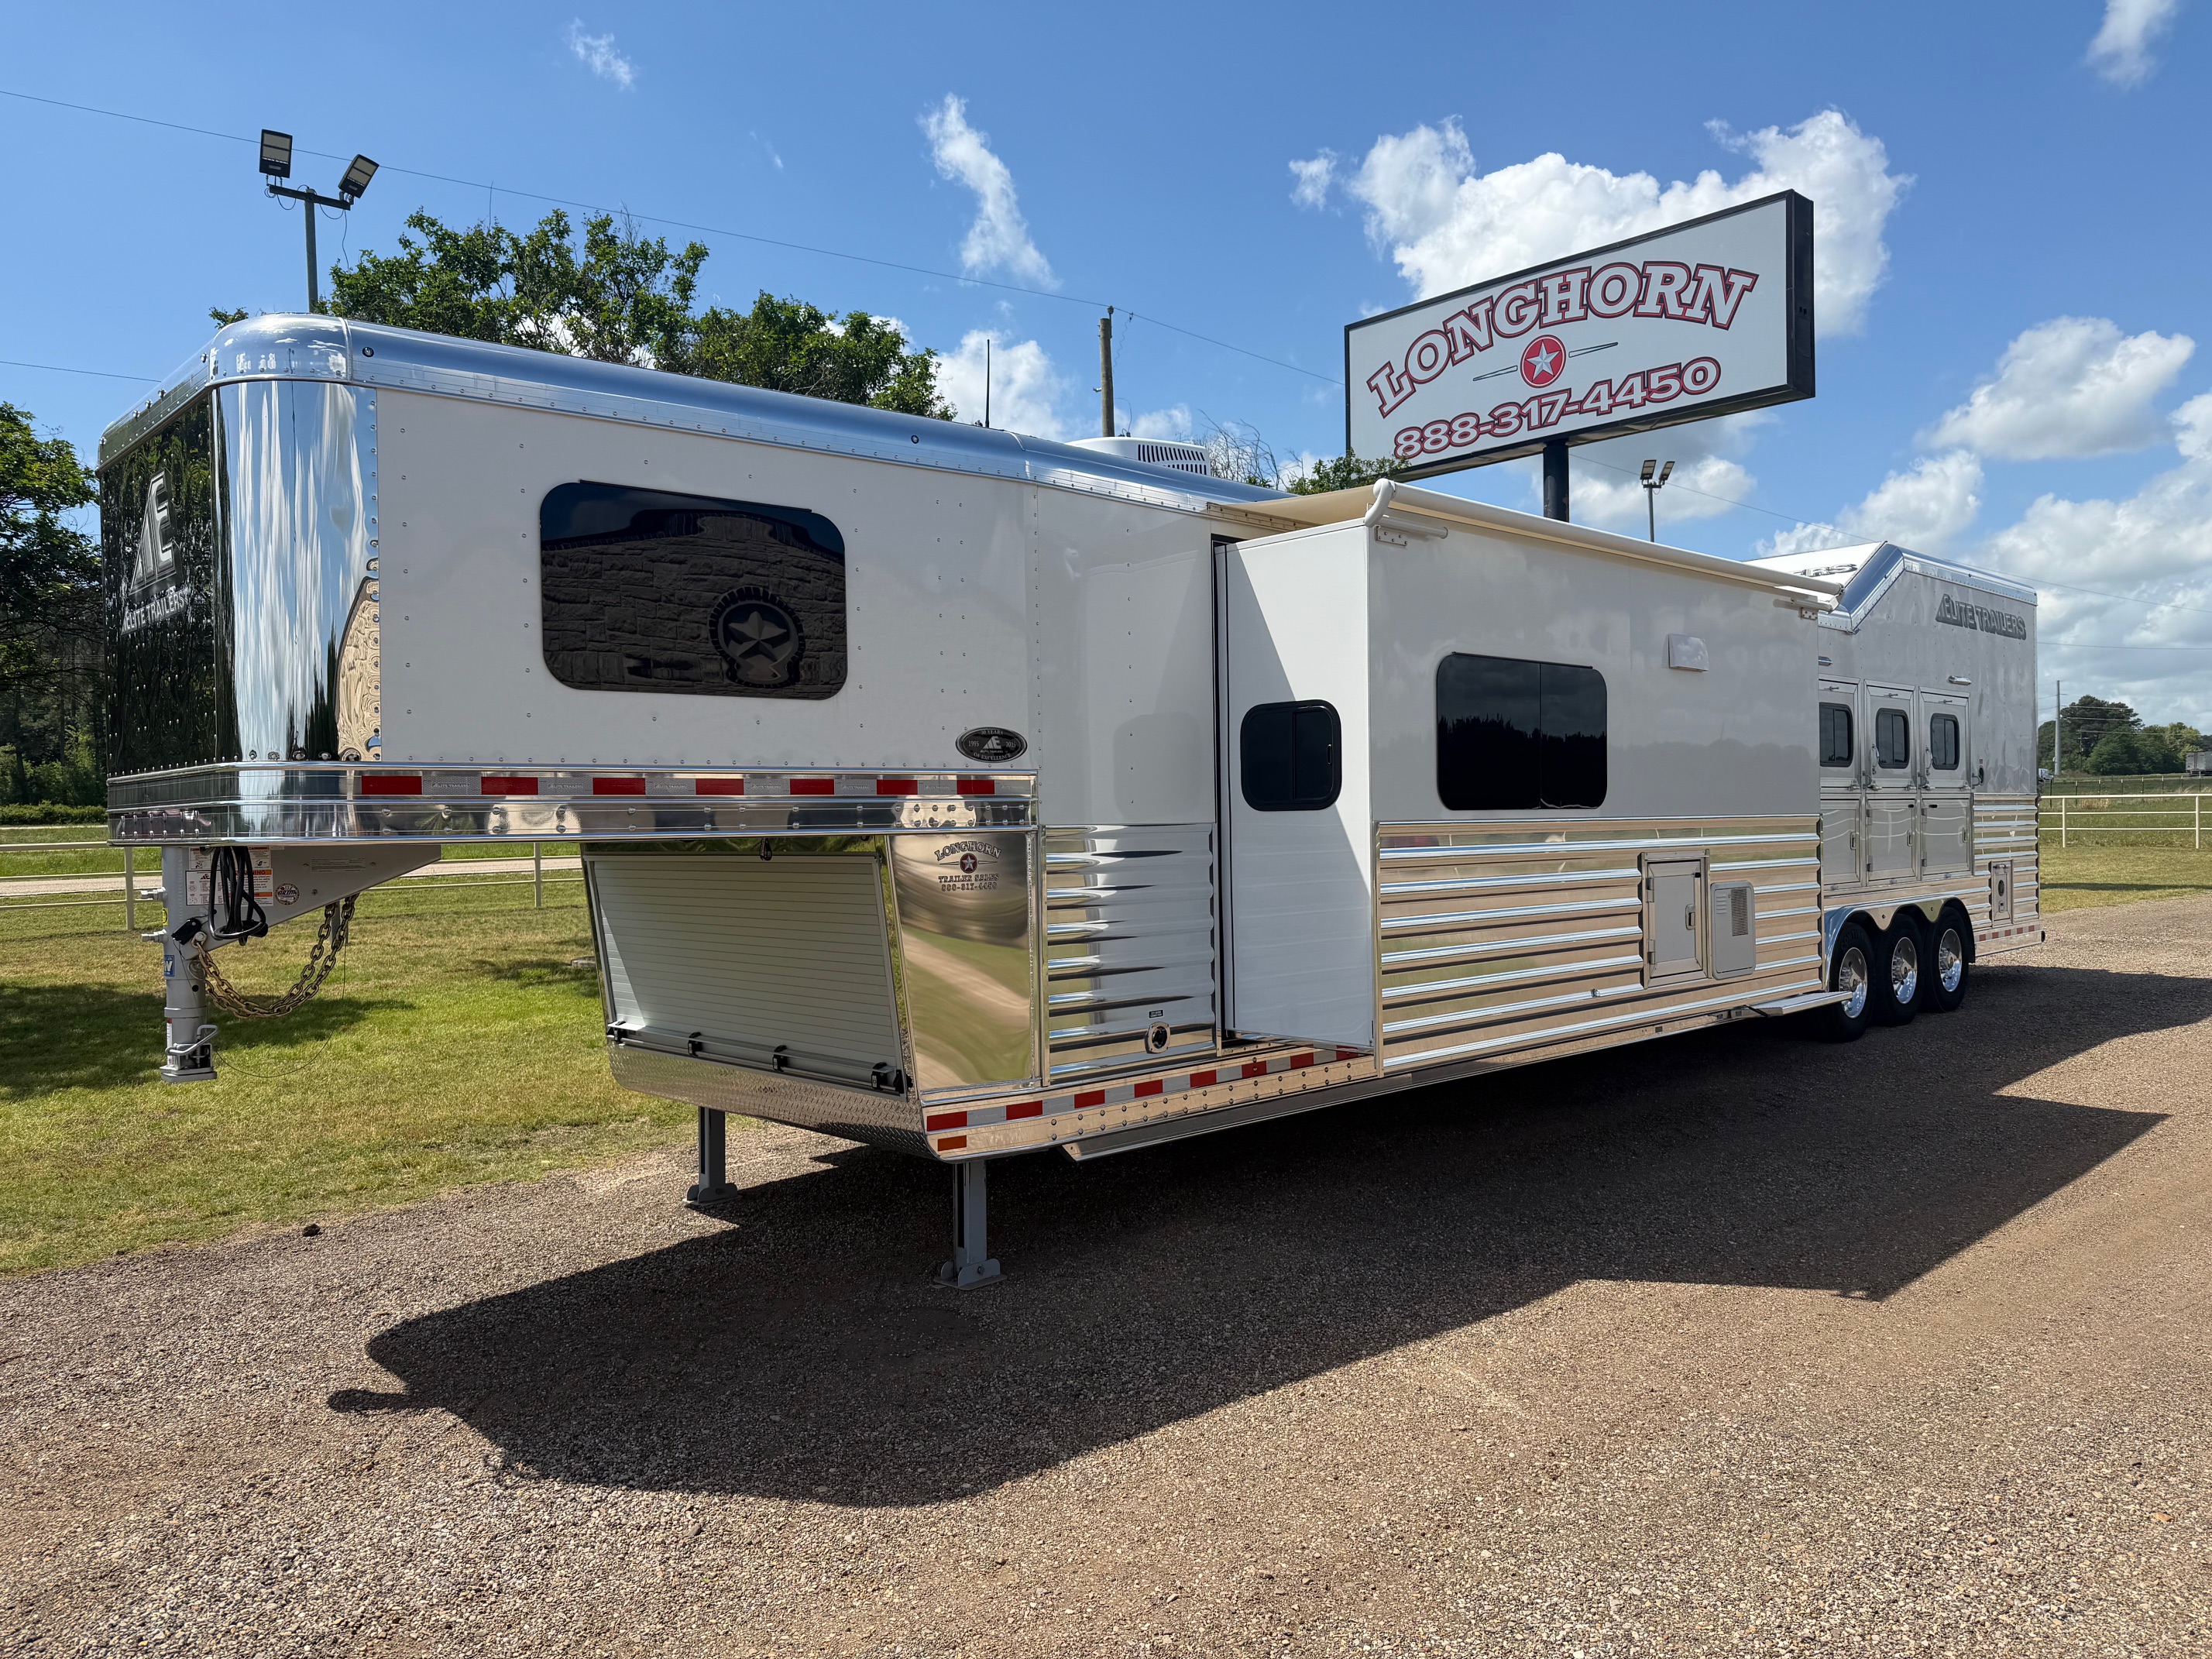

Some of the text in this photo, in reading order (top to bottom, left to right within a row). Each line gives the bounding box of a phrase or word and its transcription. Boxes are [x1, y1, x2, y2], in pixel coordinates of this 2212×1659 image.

[1367, 261, 1760, 418] LONGHORN
[1394, 356, 1721, 460] 888-317-4450
[146, 590, 187, 624] TRAILERS
[1936, 594, 2027, 641] ELITE TRAILERS
[981, 752, 1012, 761] EXCELLENCE
[934, 841, 1002, 861] LONGHORN
